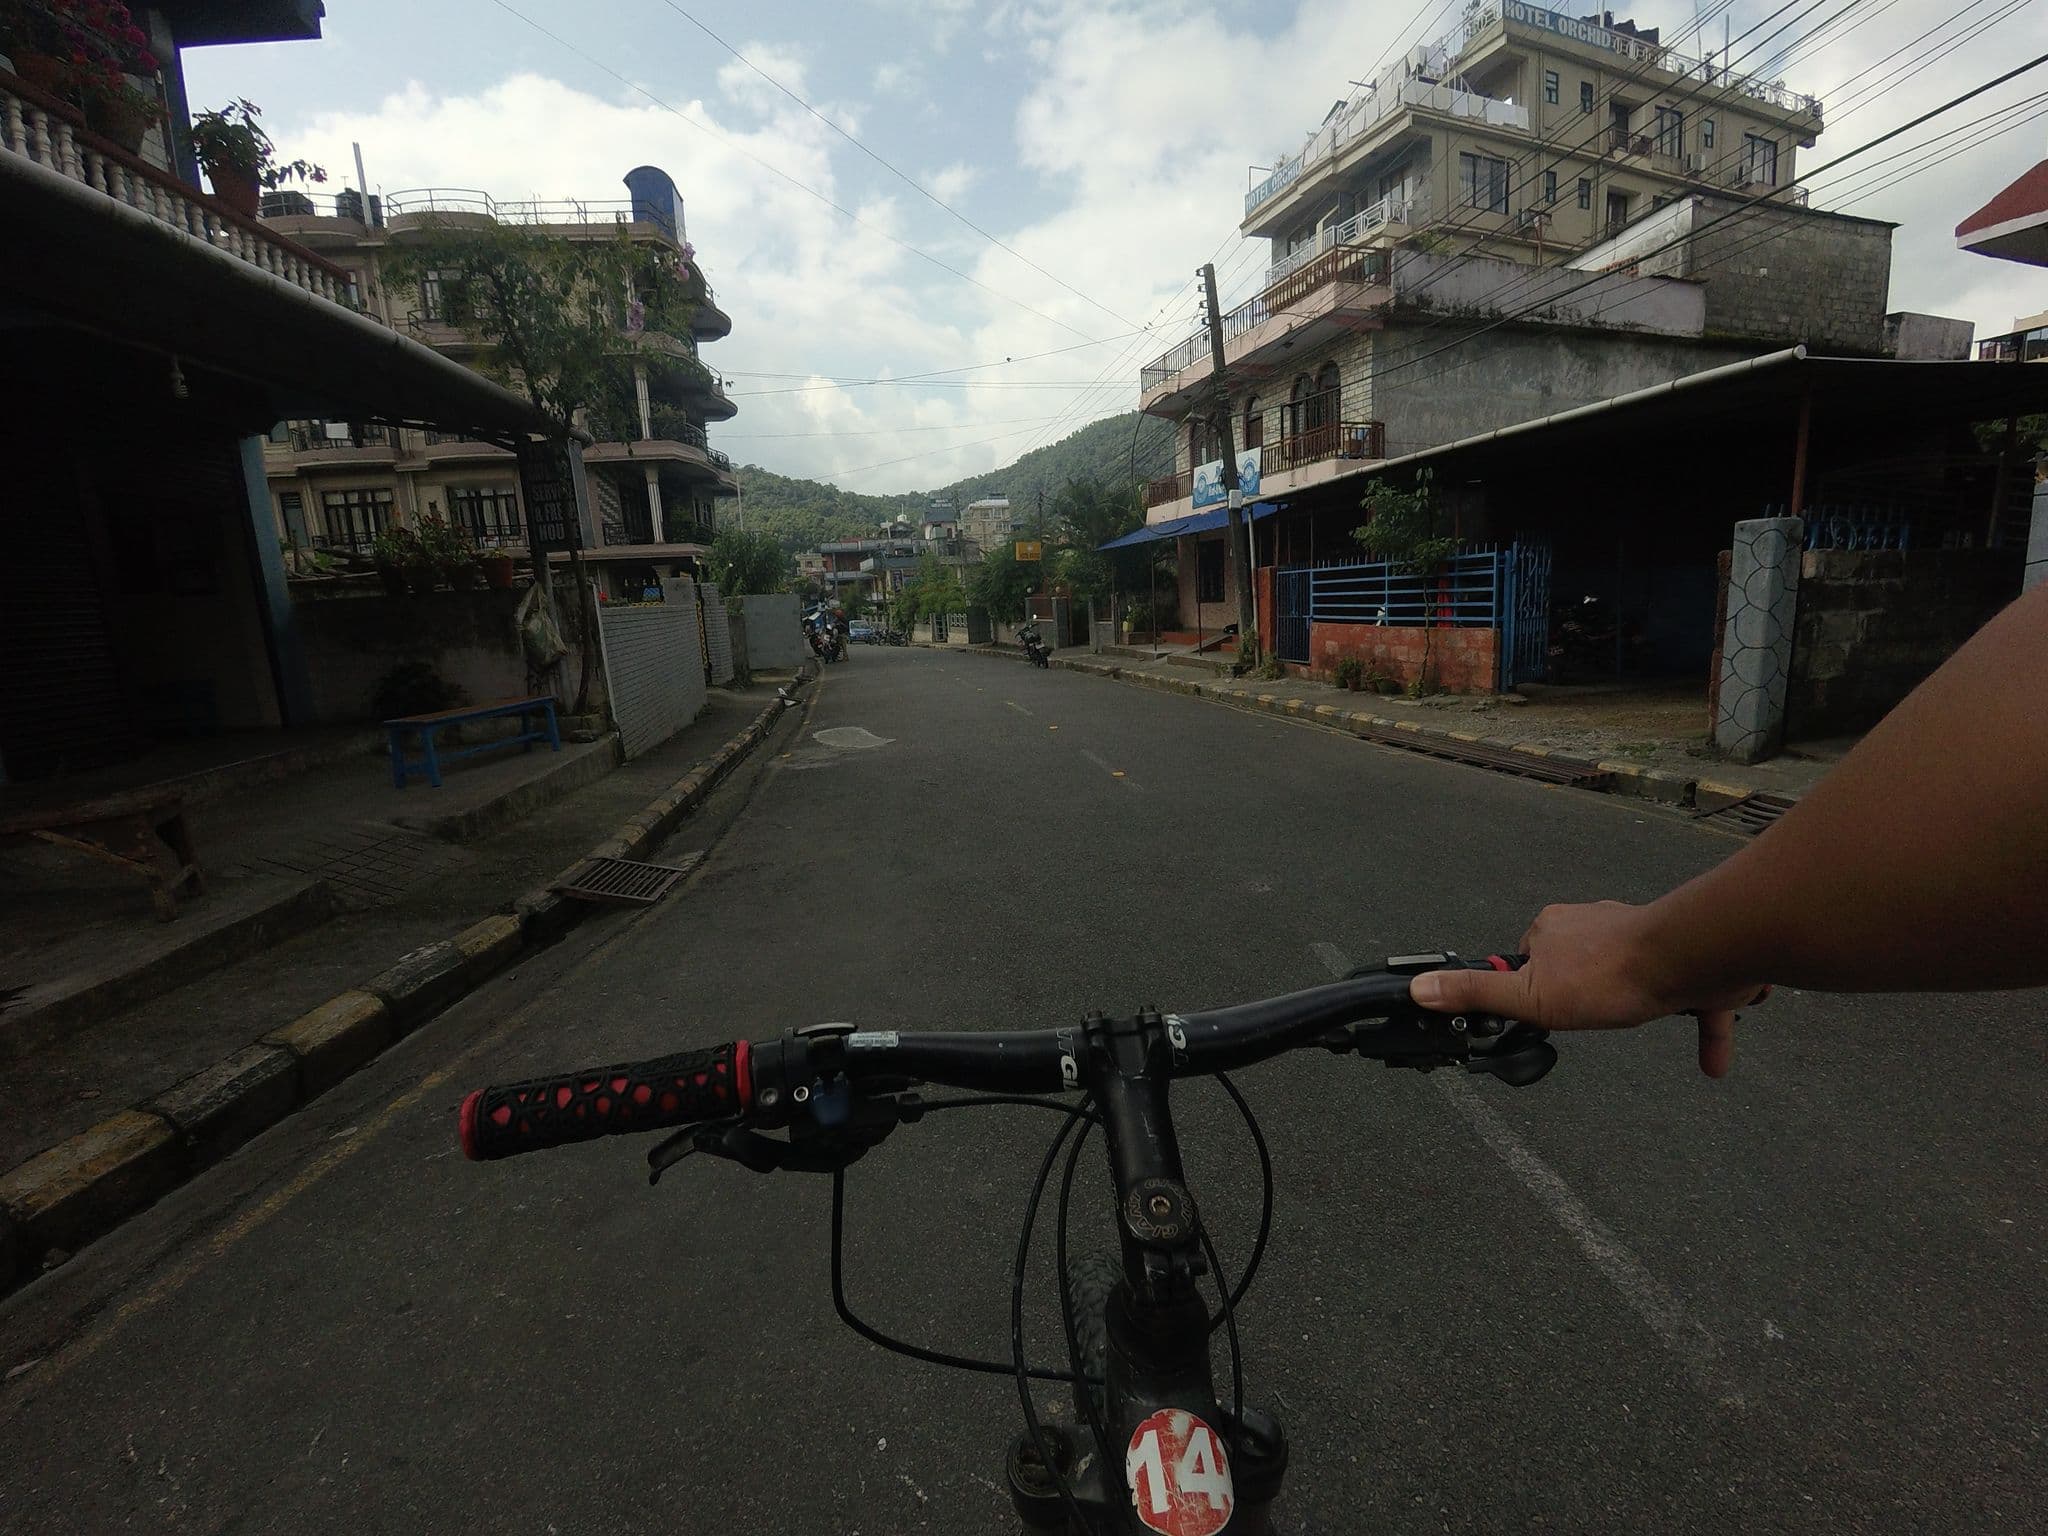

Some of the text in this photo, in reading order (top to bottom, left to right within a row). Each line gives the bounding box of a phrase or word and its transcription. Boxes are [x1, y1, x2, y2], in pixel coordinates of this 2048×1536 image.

[1505, 1, 1611, 48] HOTEL ORCHID
[1127, 1427, 1232, 1514] 14
